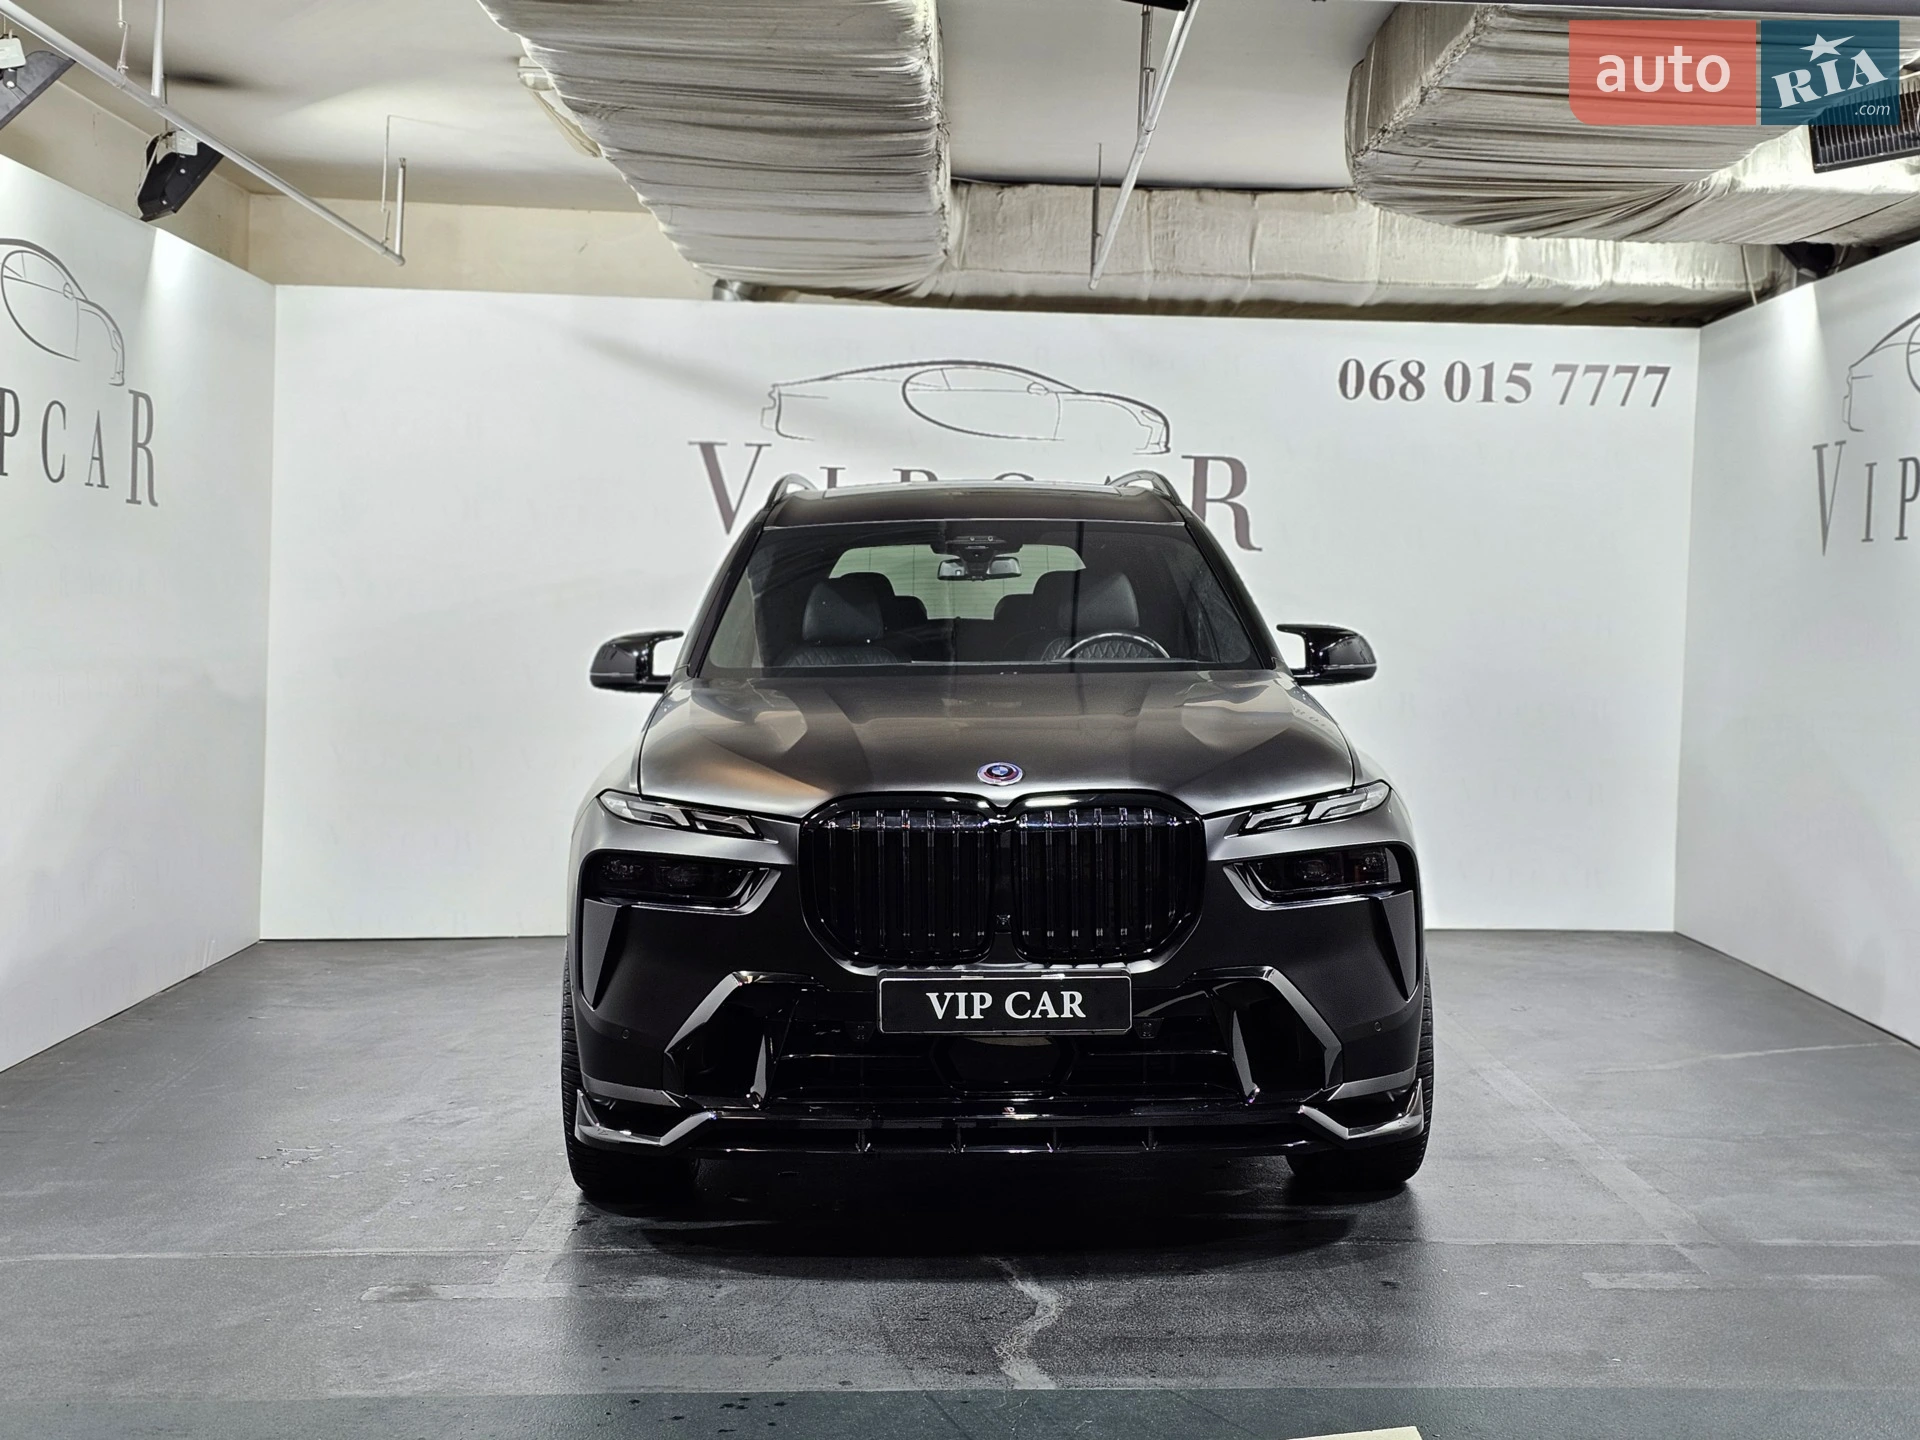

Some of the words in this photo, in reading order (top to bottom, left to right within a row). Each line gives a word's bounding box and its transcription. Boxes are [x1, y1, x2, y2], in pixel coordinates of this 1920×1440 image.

[1338, 358, 1426, 402] 068
[1444, 360, 1533, 404] 015
[1551, 363, 1672, 407] 7777
[925, 992, 993, 1020] VIP
[1004, 991, 1087, 1019] CAR
